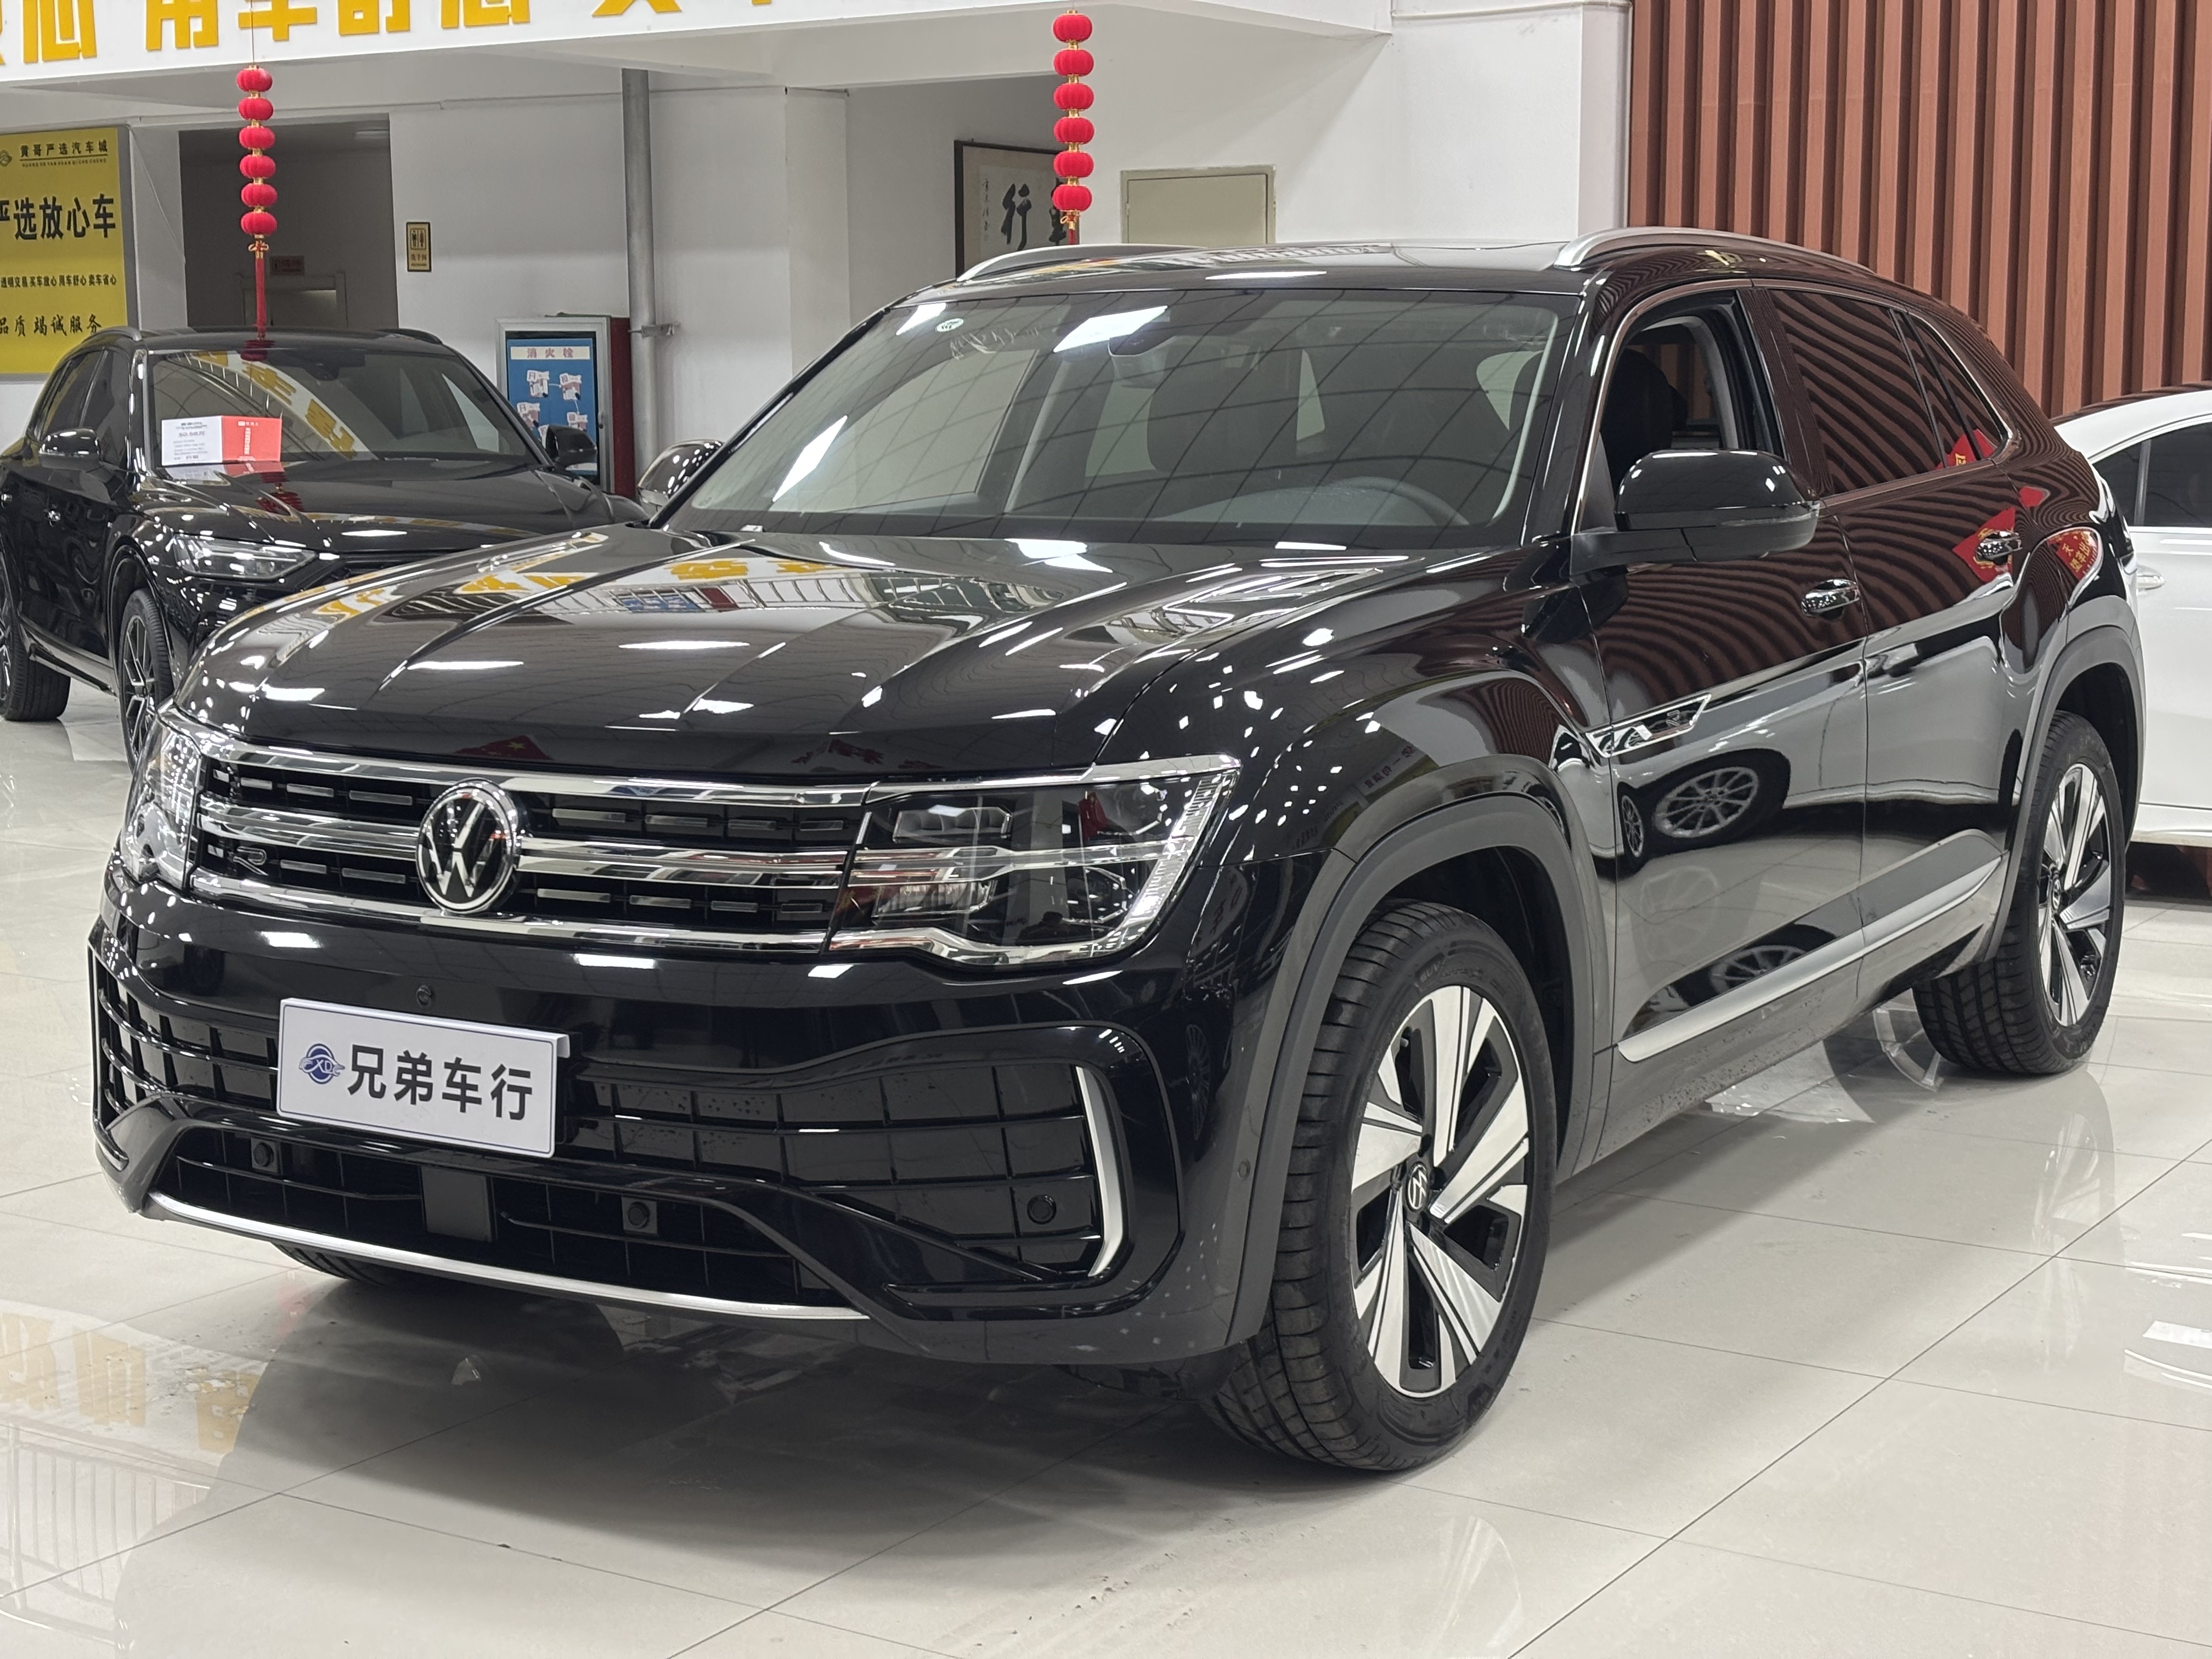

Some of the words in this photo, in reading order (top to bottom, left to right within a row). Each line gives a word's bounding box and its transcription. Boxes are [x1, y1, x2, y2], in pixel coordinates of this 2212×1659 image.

[20, 139, 108, 157] 黄哥严选汽车城
[1001, 183, 1032, 250] 行
[527, 347, 574, 358] 消火栓
[347, 1044, 532, 1121] 兄弟车行
